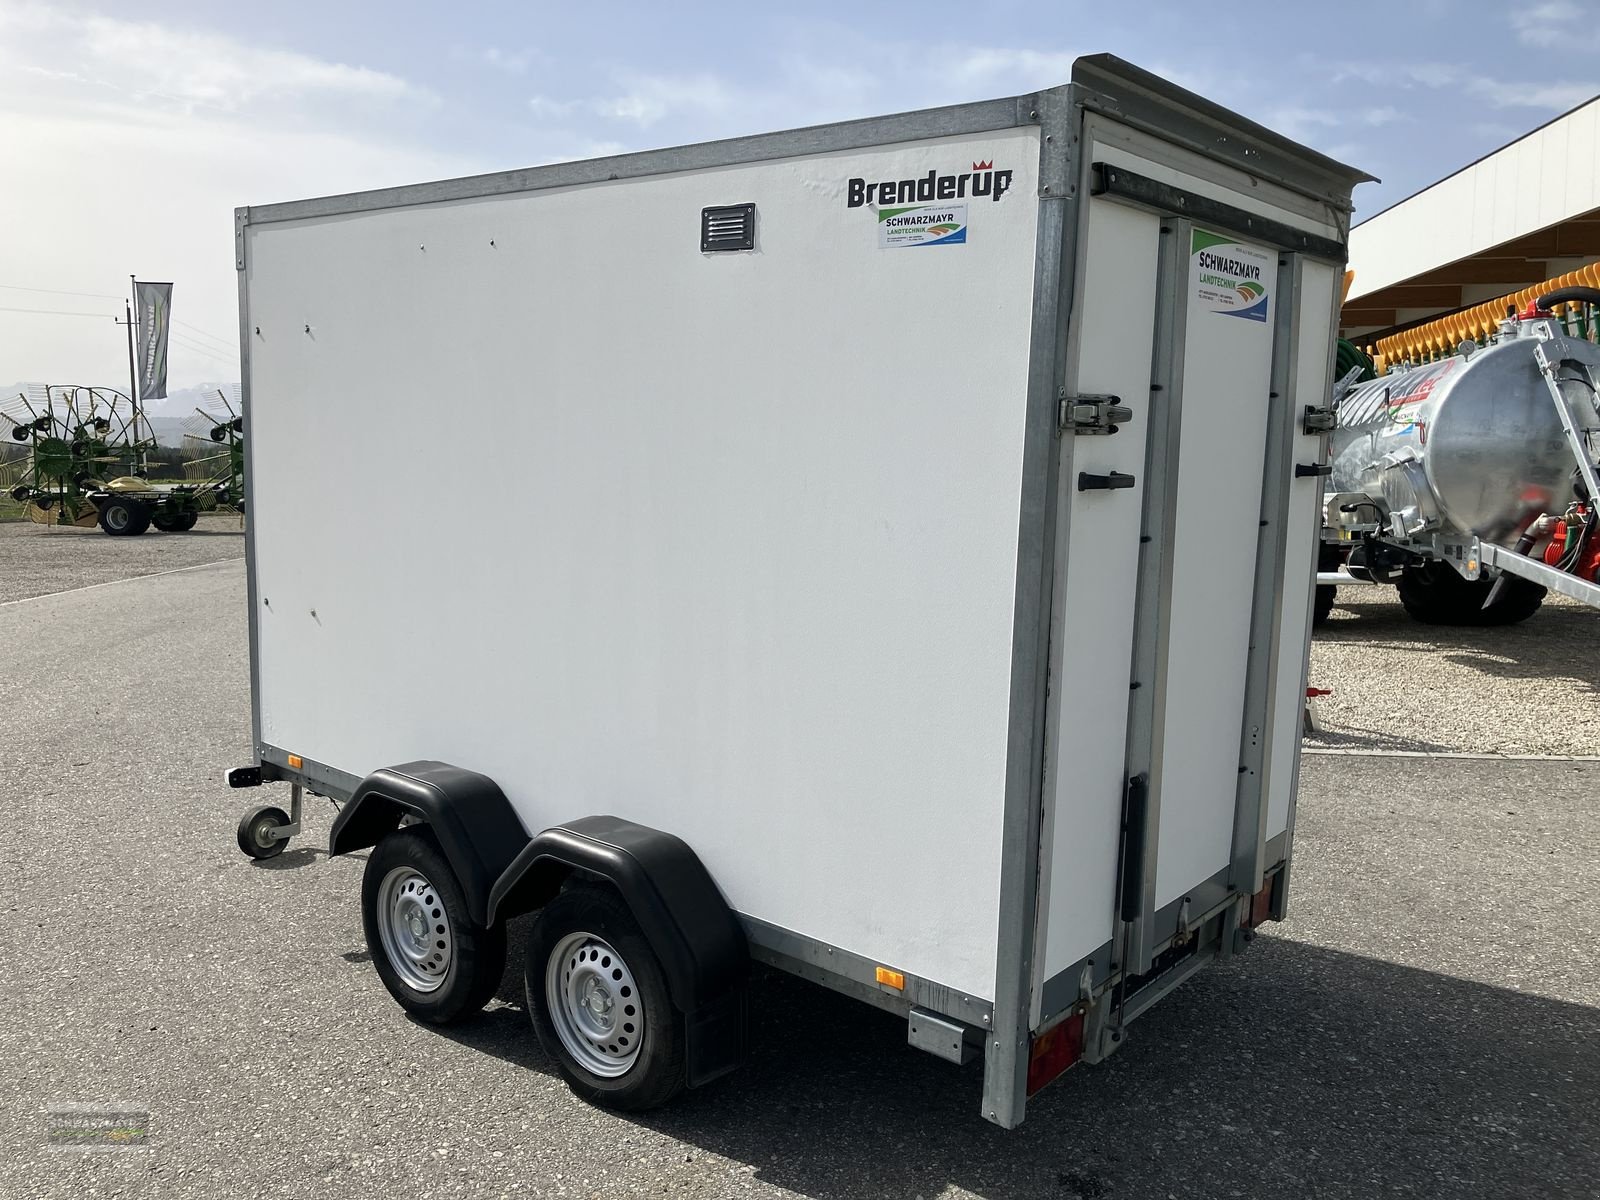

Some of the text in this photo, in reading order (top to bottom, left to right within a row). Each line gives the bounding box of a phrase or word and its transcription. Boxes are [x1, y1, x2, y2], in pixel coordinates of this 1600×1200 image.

[847, 170, 1013, 208] Brenderup
[886, 213, 954, 227] SCHWARZMAYR
[887, 227, 926, 235] LANDTECHNIK
[1199, 251, 1260, 280] SCHWARZMAYR
[1199, 272, 1237, 289] LANDTECHNIK
